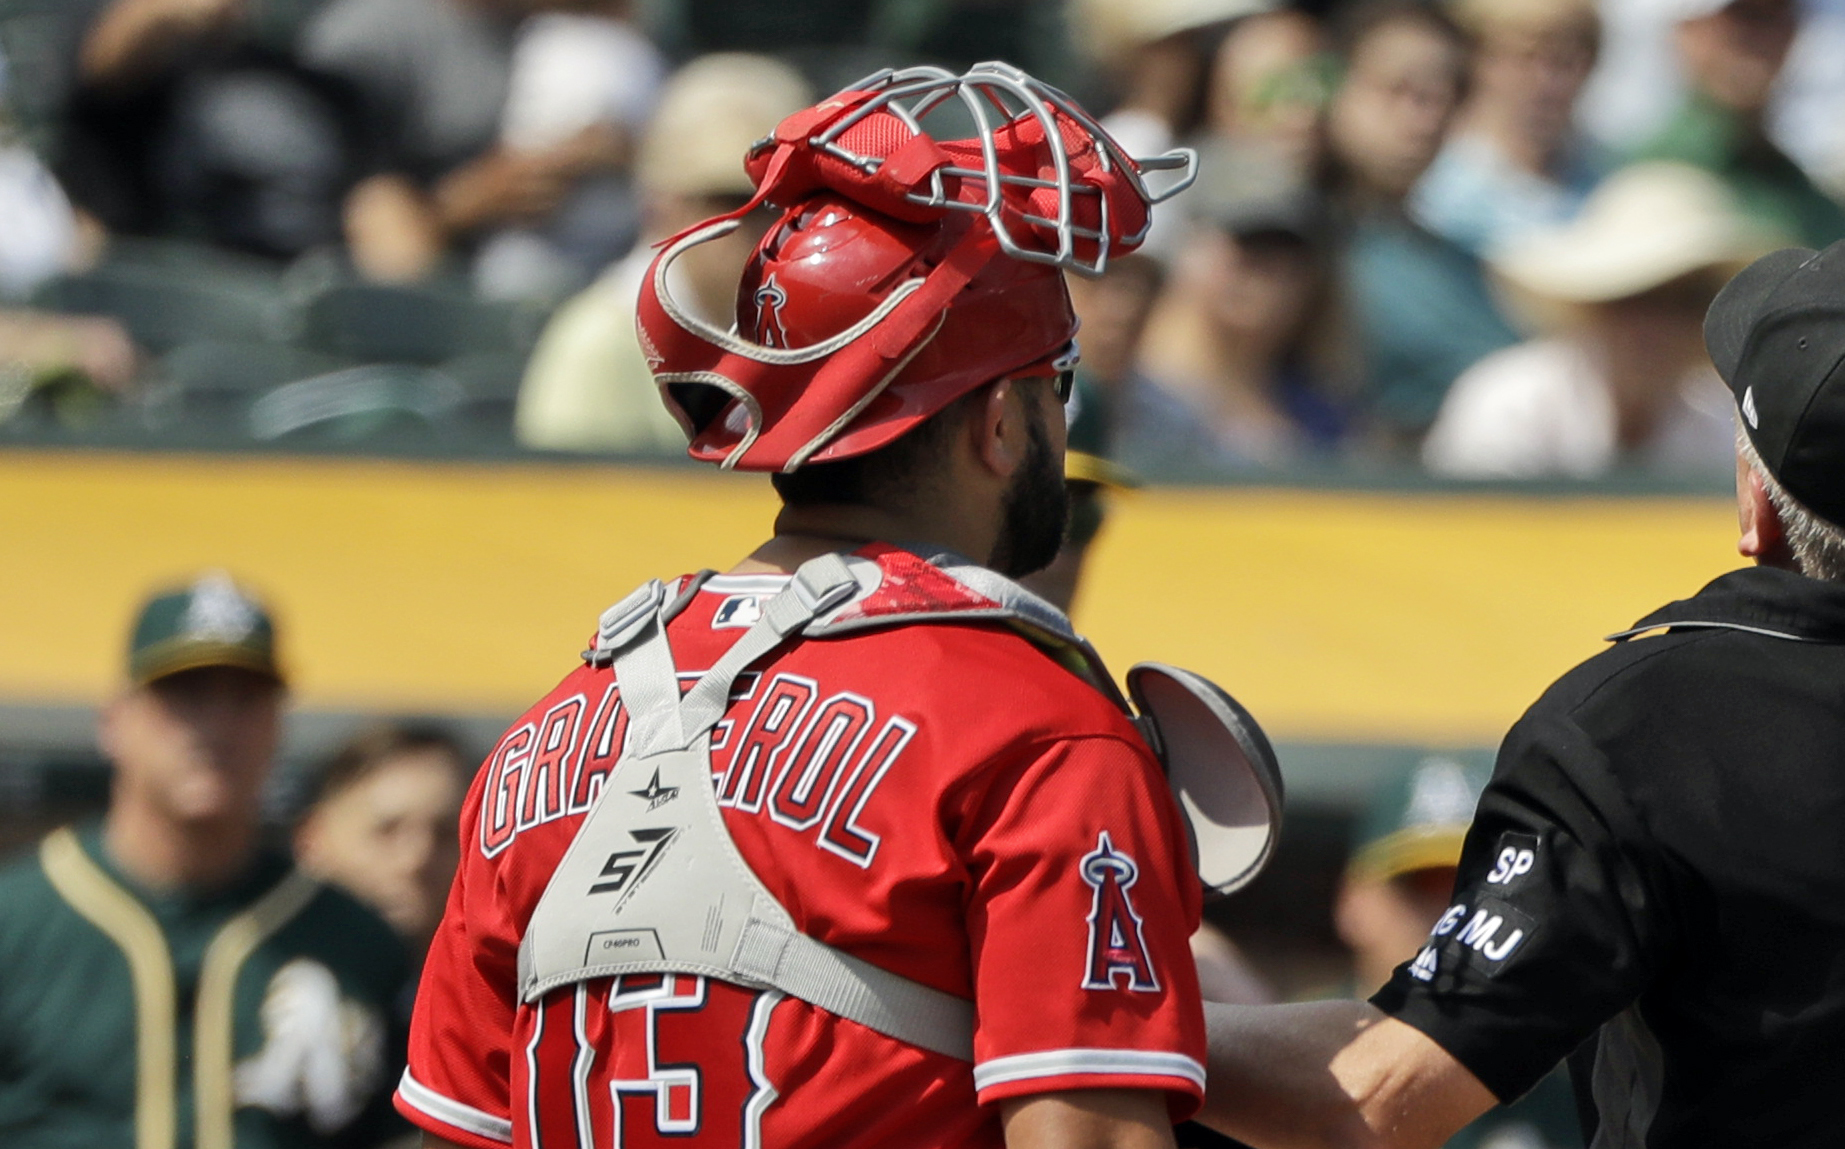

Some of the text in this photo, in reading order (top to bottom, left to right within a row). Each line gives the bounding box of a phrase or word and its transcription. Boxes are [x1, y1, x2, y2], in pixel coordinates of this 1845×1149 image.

[1486, 846, 1535, 884] SP
[1080, 831, 1161, 992] A
[1456, 908, 1524, 961] MJ
